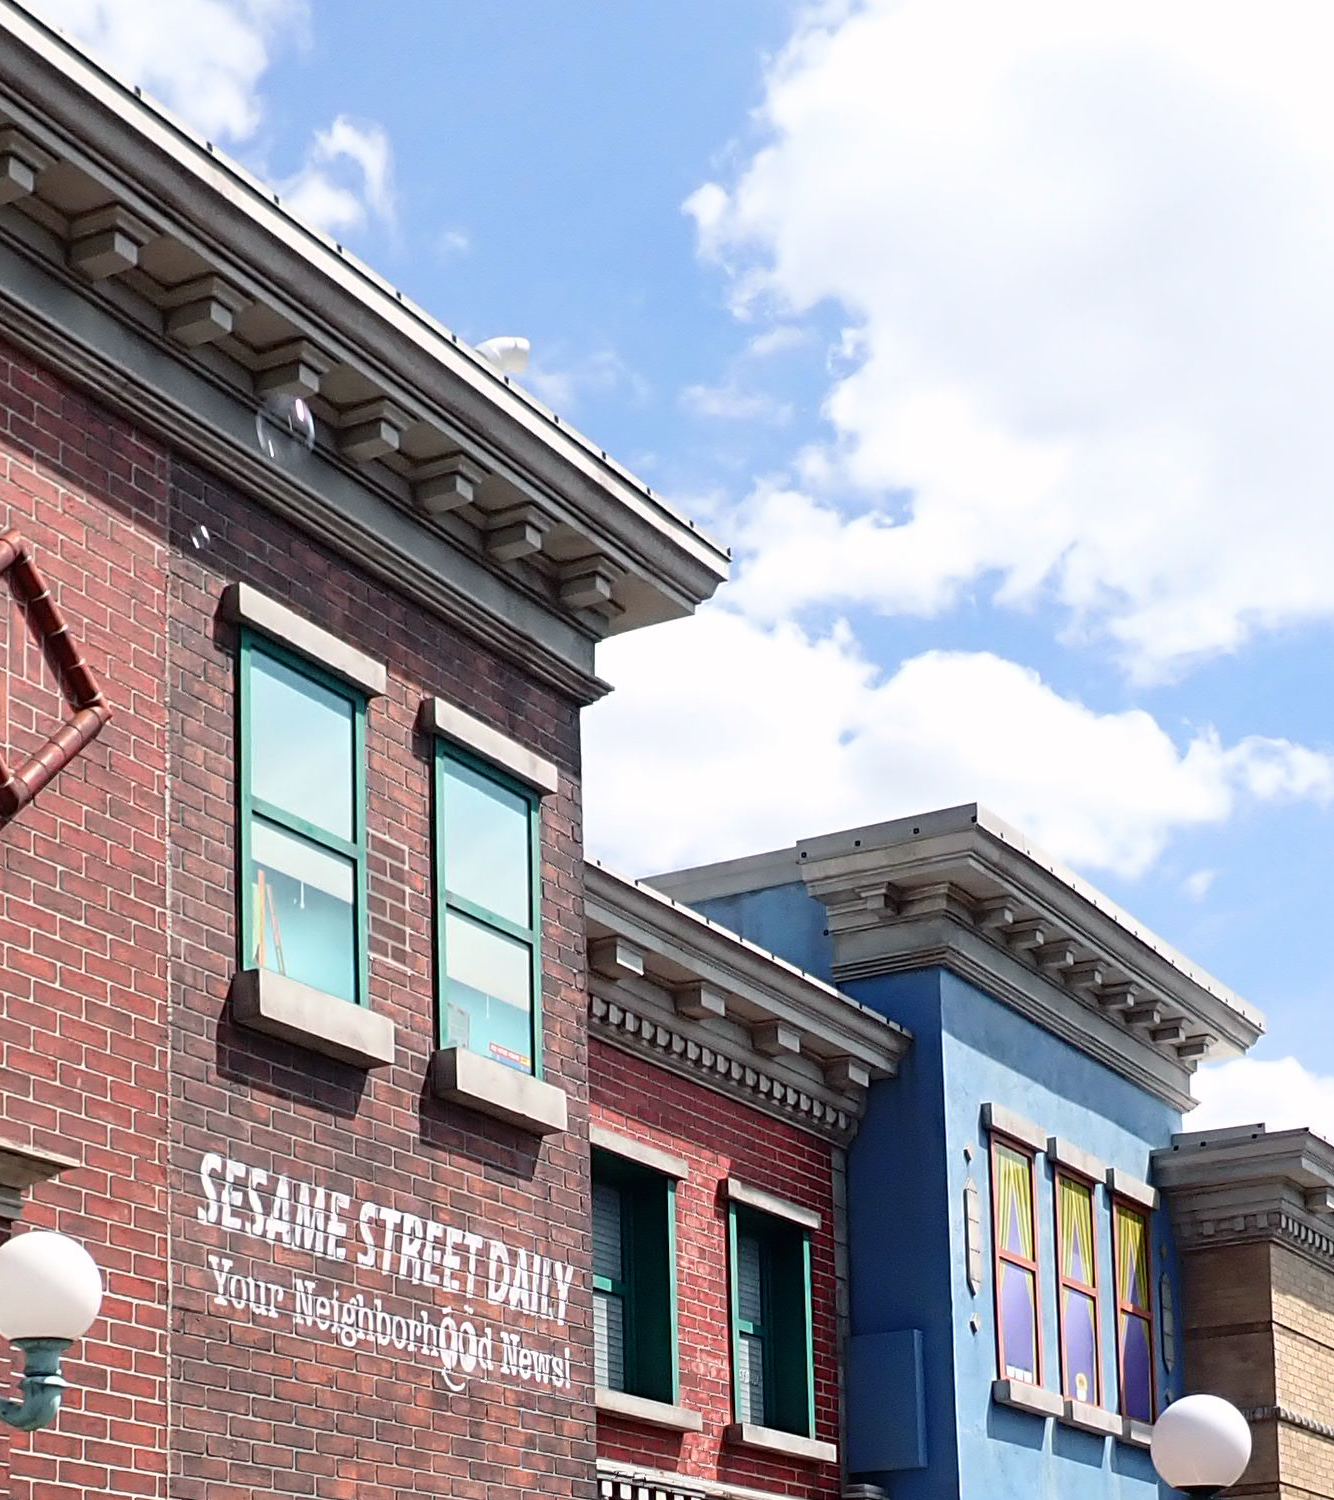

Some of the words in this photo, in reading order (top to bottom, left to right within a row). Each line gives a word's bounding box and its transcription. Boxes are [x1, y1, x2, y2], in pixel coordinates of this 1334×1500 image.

[197, 1152, 353, 1262] SESAME
[356, 1201, 485, 1299] STREET
[485, 1239, 575, 1327] DAILY
[207, 1255, 285, 1320] Your
[499, 1333, 573, 1389] News!
